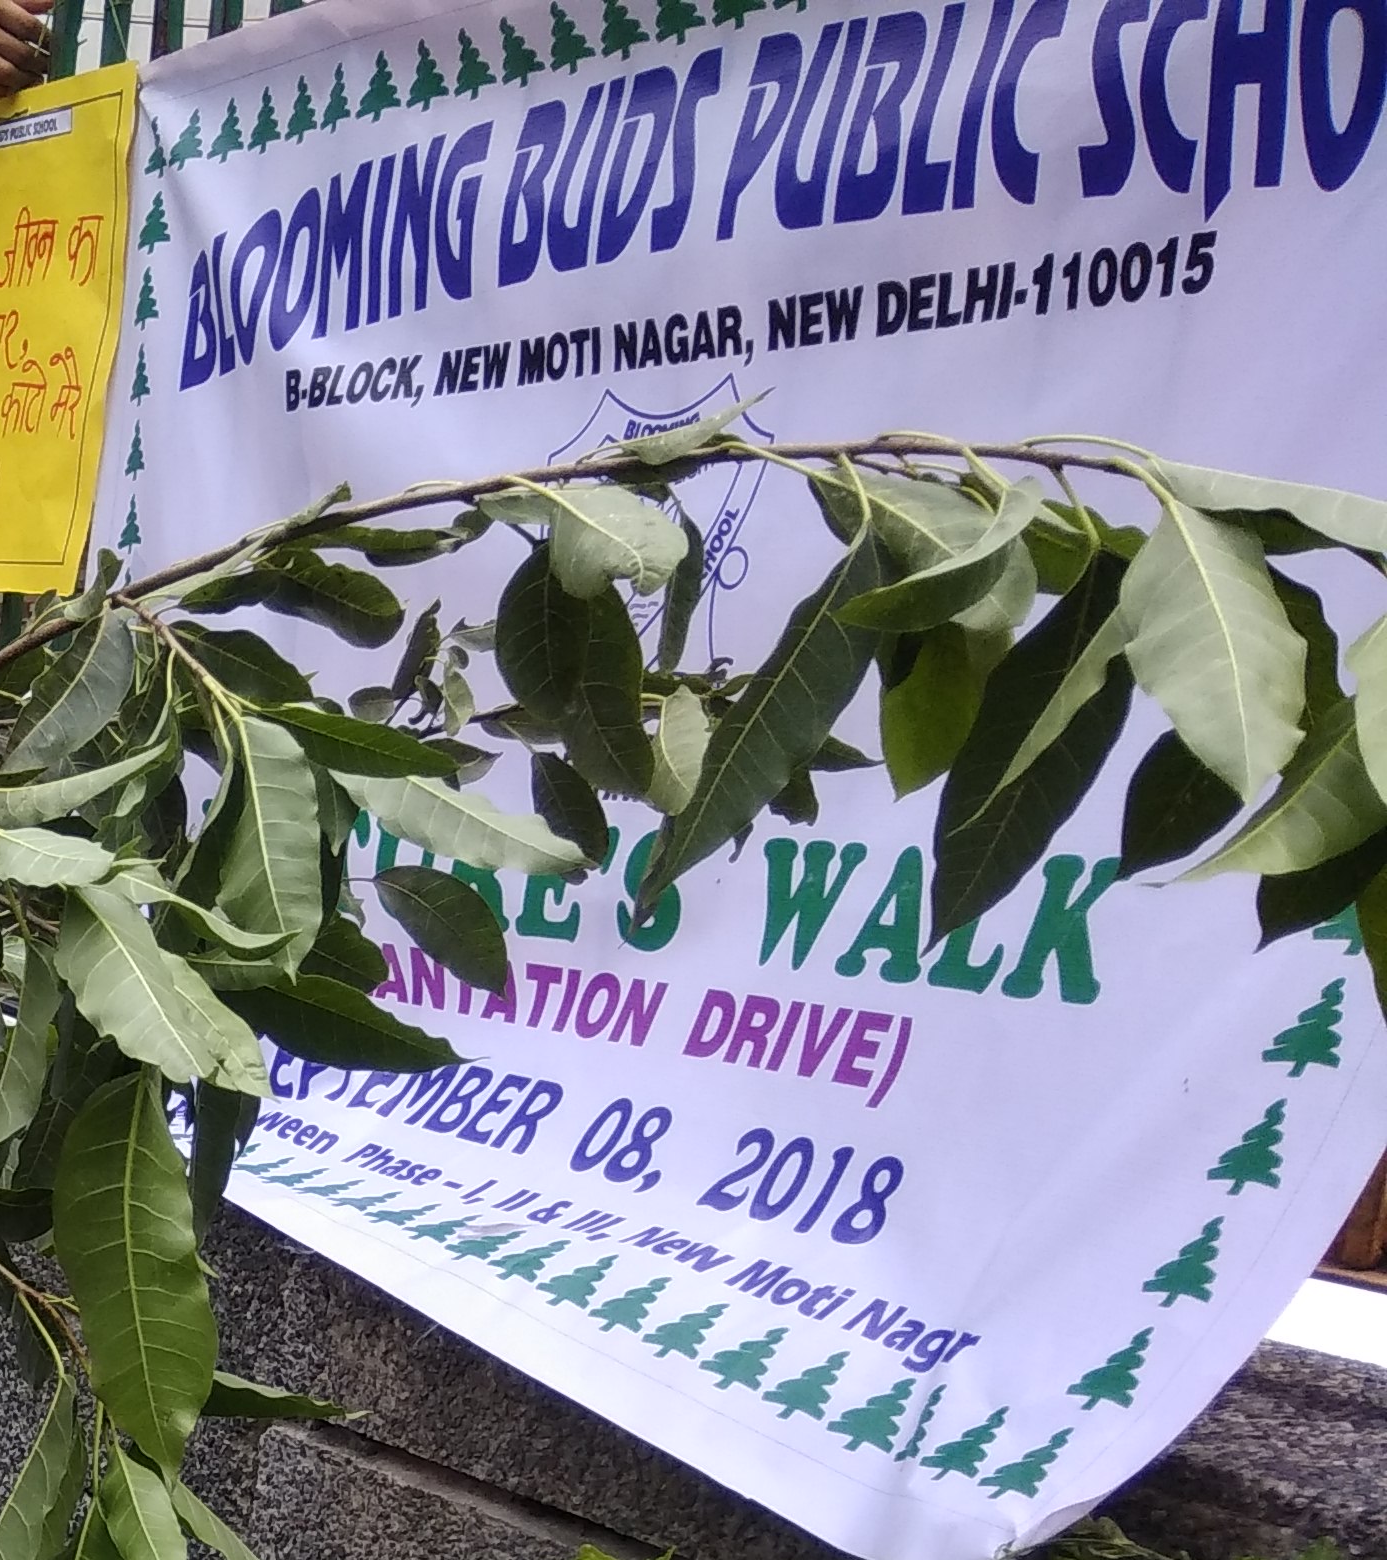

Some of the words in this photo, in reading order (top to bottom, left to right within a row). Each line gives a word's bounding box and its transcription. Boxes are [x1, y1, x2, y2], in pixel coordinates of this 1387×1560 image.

[68, 214, 104, 287] का
[180, 121, 495, 392] BLOOMING
[498, 47, 723, 288] BUDS
[715, 0, 1071, 241] PUBLIC
[285, 354, 425, 413] B-BLOCK,
[433, 340, 513, 397] NEW
[517, 327, 601, 387] MOTI
[613, 304, 754, 372] NAGAR,
[768, 285, 864, 352] NEW
[875, 231, 1217, 337] DELHI-110015
[759, 838, 1122, 1004] WALK
[683, 988, 913, 1109] DRIVE)
[570, 1098, 673, 1193] 08,
[697, 1128, 904, 1245] 2018
[342, 1142, 442, 1187] Phase
[527, 1200, 573, 1224] &
[619, 1226, 735, 1273] New
[723, 1259, 857, 1321] Moti
[841, 1298, 982, 1373] Nagr
